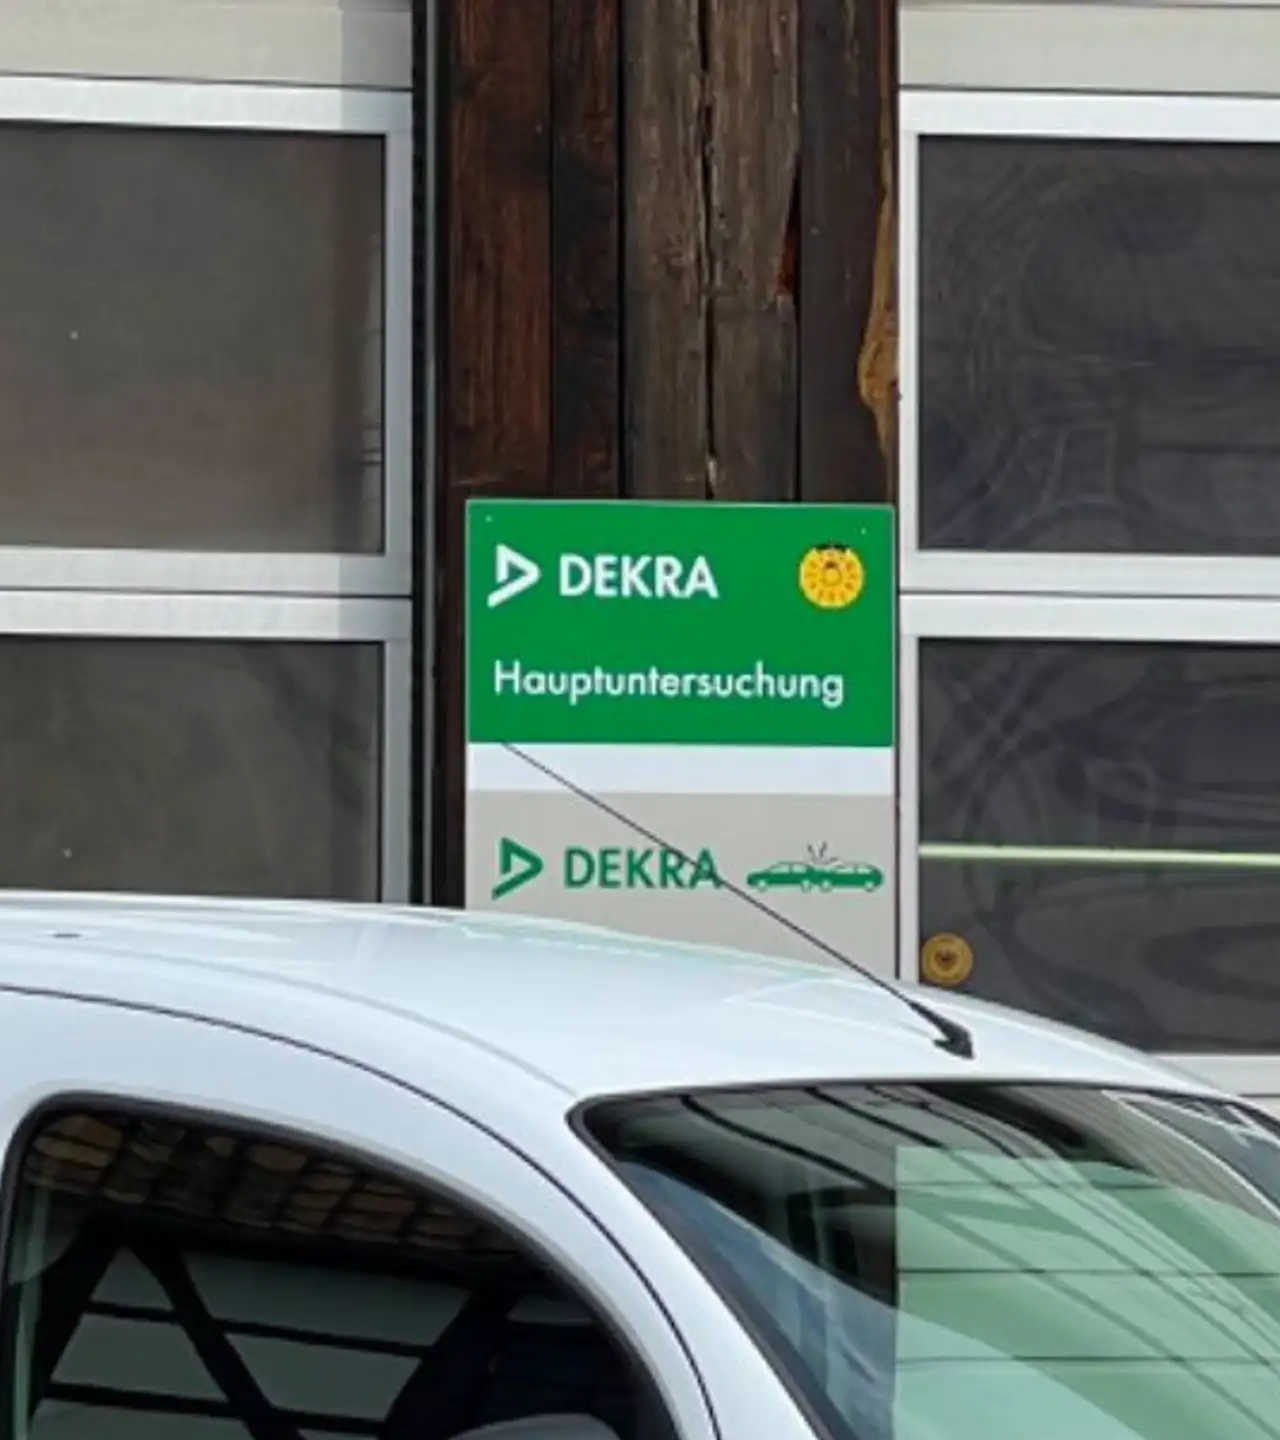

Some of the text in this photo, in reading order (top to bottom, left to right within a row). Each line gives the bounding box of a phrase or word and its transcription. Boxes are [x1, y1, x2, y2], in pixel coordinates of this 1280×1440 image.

[559, 553, 719, 599] DEKRA
[494, 659, 844, 709] Hauptuntersuchung
[563, 847, 721, 890] DEKRA
